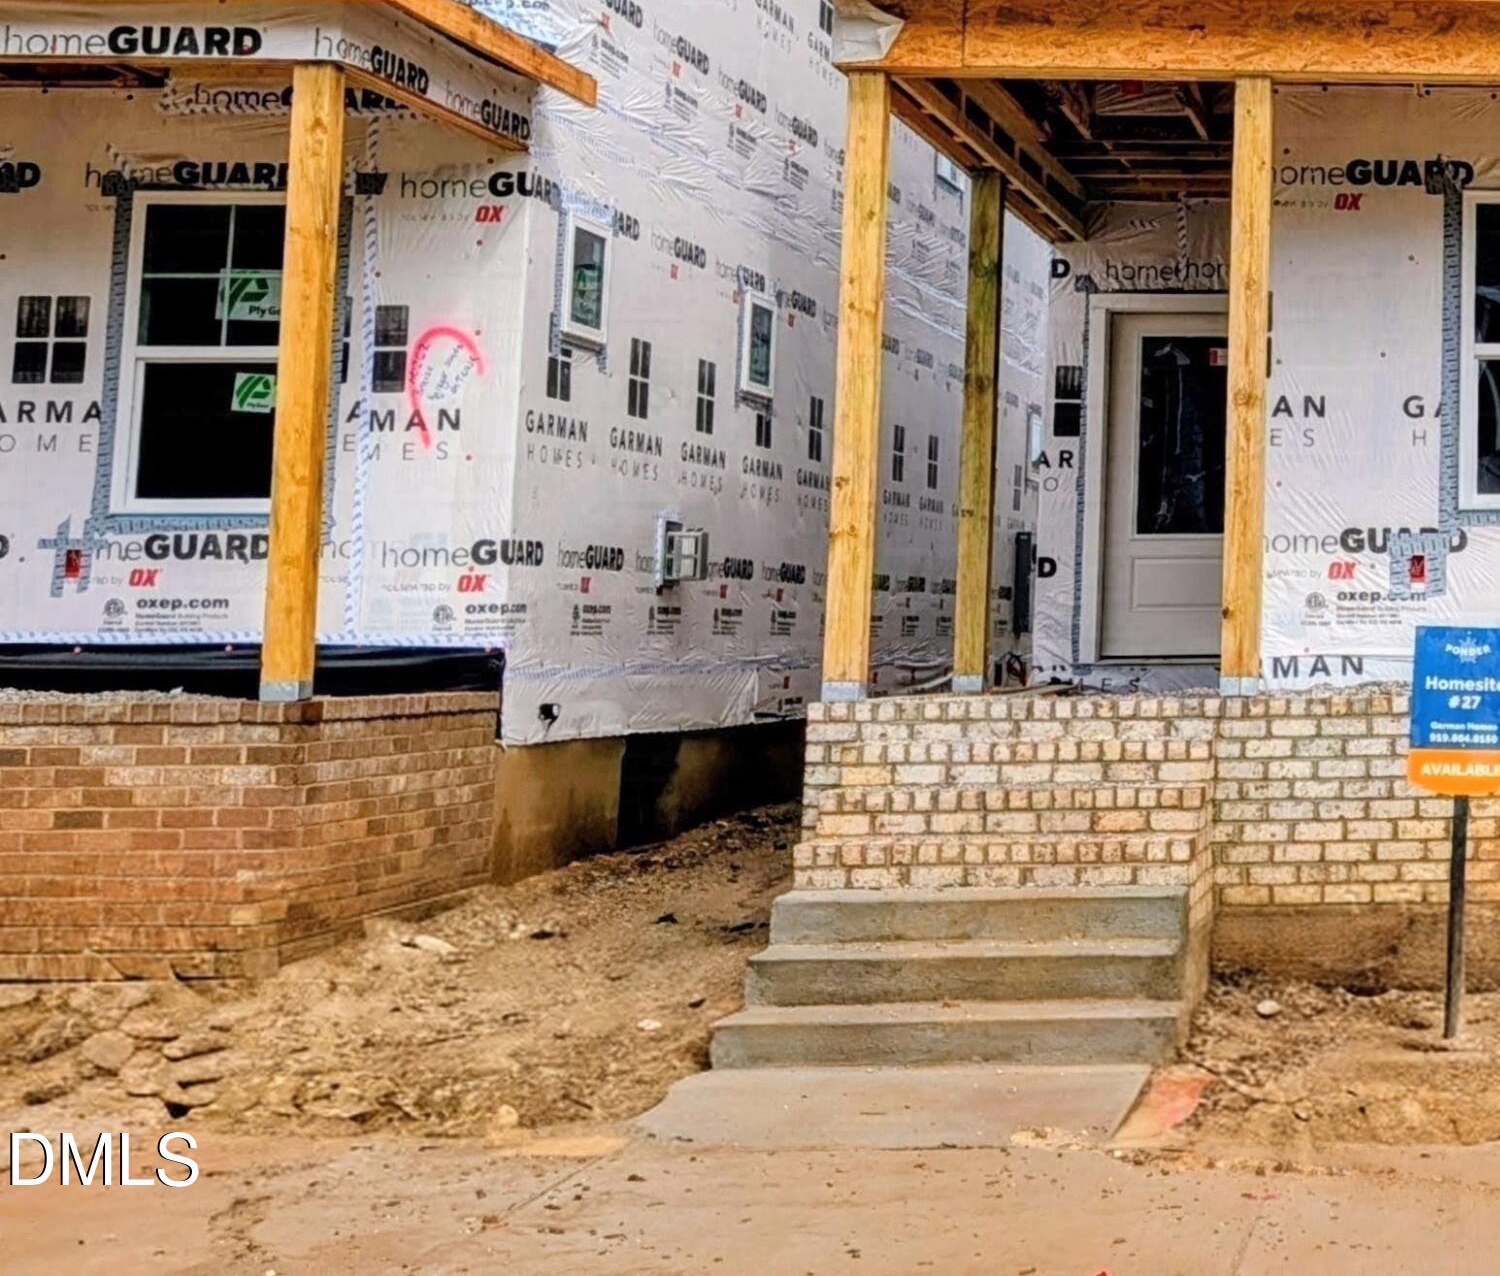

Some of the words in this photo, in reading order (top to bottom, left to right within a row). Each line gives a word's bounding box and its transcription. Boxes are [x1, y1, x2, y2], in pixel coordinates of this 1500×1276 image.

[4, 25, 263, 56] homeGUARD
[314, 27, 430, 96] homeGUARD
[445, 79, 532, 142] homeGUARD
[475, 205, 505, 223] OX
[1334, 193, 1364, 211] OX
[249, 306, 267, 317] Ply
[525, 409, 588, 443] GARMAN
[609, 427, 663, 458] GARMAN
[527, 443, 583, 469] HOMES
[681, 442, 726, 470] GARMAN
[742, 455, 783, 482] GARMAN
[381, 539, 544, 568] homeGUARD
[557, 541, 625, 572] homeGUARD
[128, 568, 160, 587] OX
[456, 574, 487, 593] OX
[1328, 562, 1357, 580] OX
[136, 596, 230, 611] oxep.com
[1445, 643, 1491, 657] PONDER
[1448, 695, 1482, 709] #27
